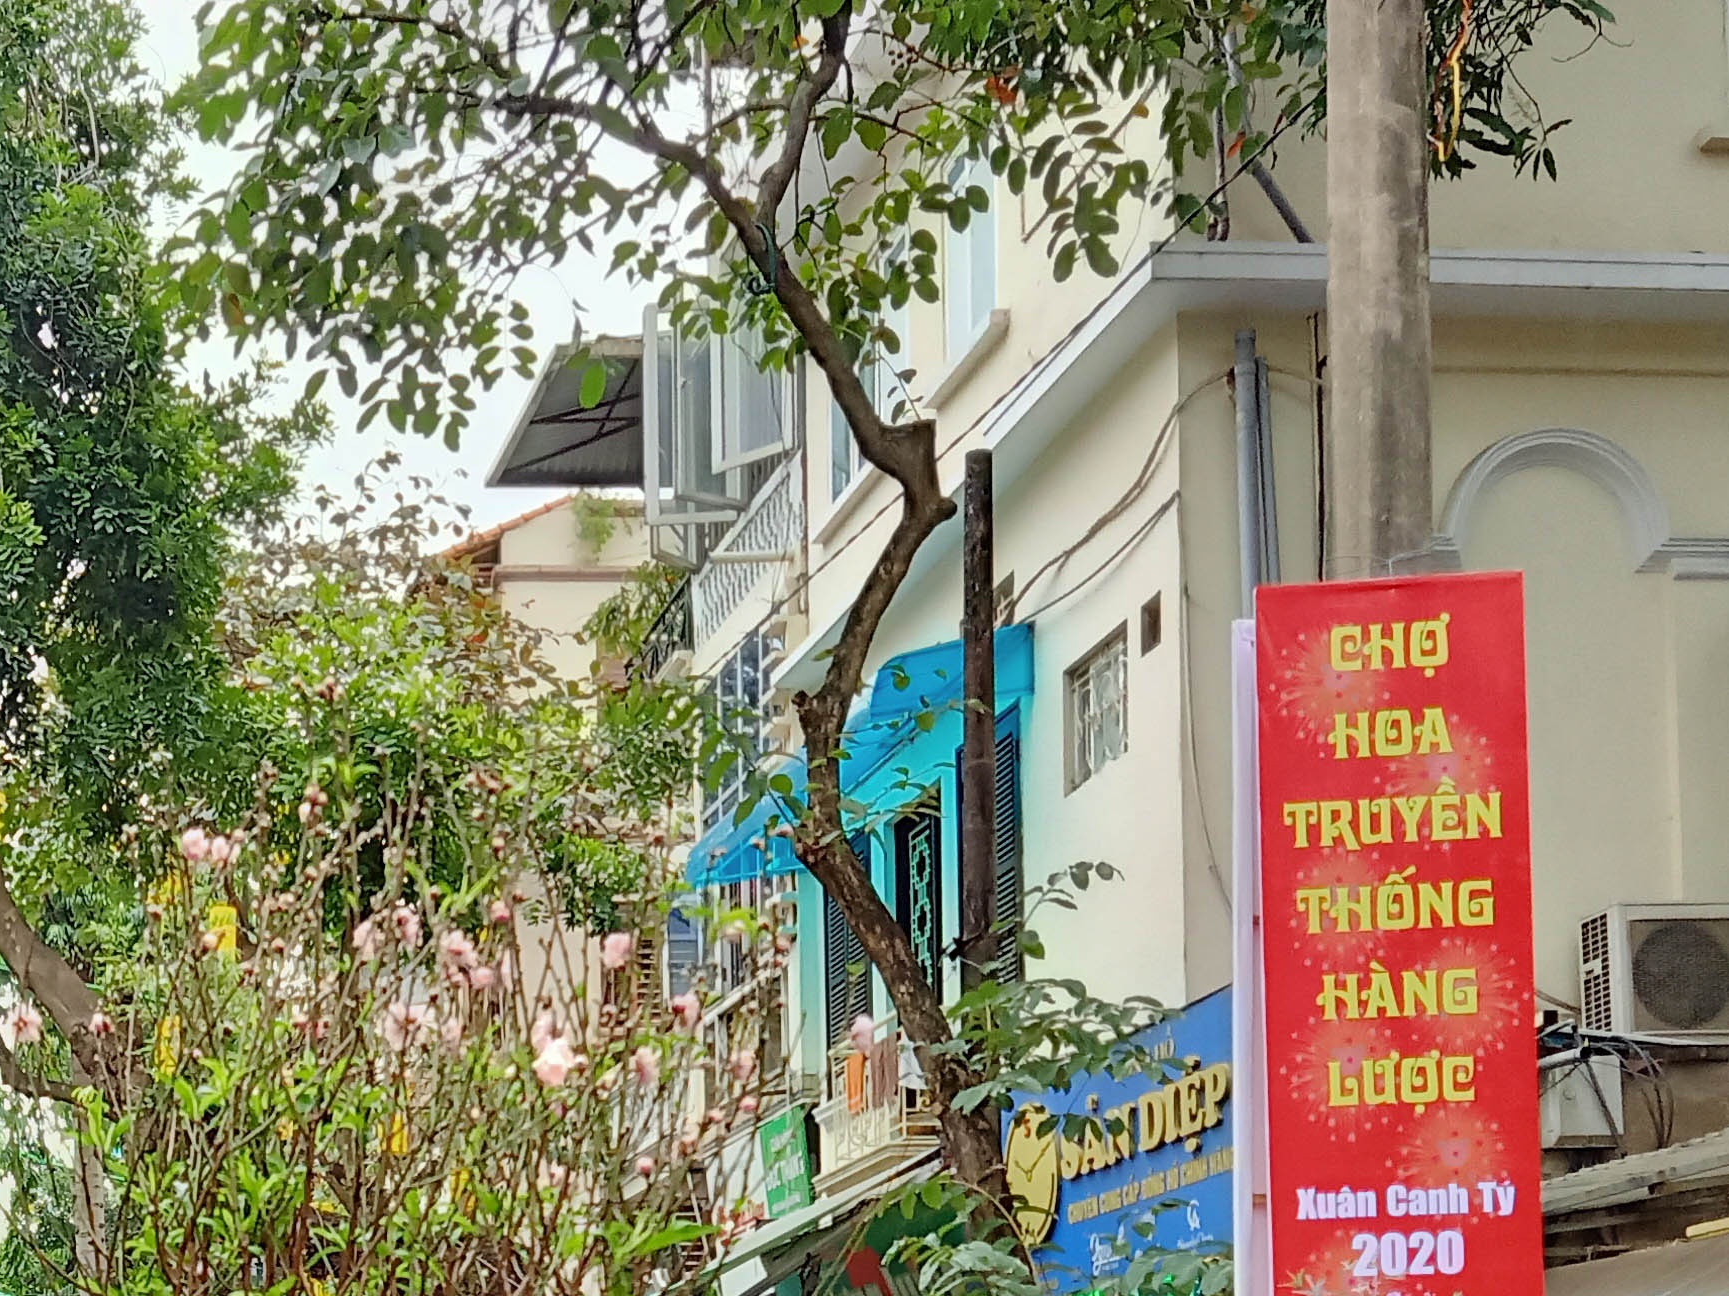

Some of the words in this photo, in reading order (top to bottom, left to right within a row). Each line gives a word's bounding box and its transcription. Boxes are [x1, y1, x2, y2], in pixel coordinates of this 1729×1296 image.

[1329, 612, 1450, 677] CHỢ
[1328, 707, 1453, 759] HOA
[1283, 775, 1502, 850] TRUYỀN
[1295, 864, 1495, 934] THỐNG
[1315, 960, 1478, 1021] HÀNG
[1138, 1055, 1232, 1153] DIỆP
[1327, 1050, 1476, 1114] LƯỢC
[1295, 1186, 1377, 1220] Xuân
[1386, 1183, 1469, 1217] Canh
[1477, 1179, 1516, 1217] Tý
[1351, 1230, 1465, 1277] 2020
